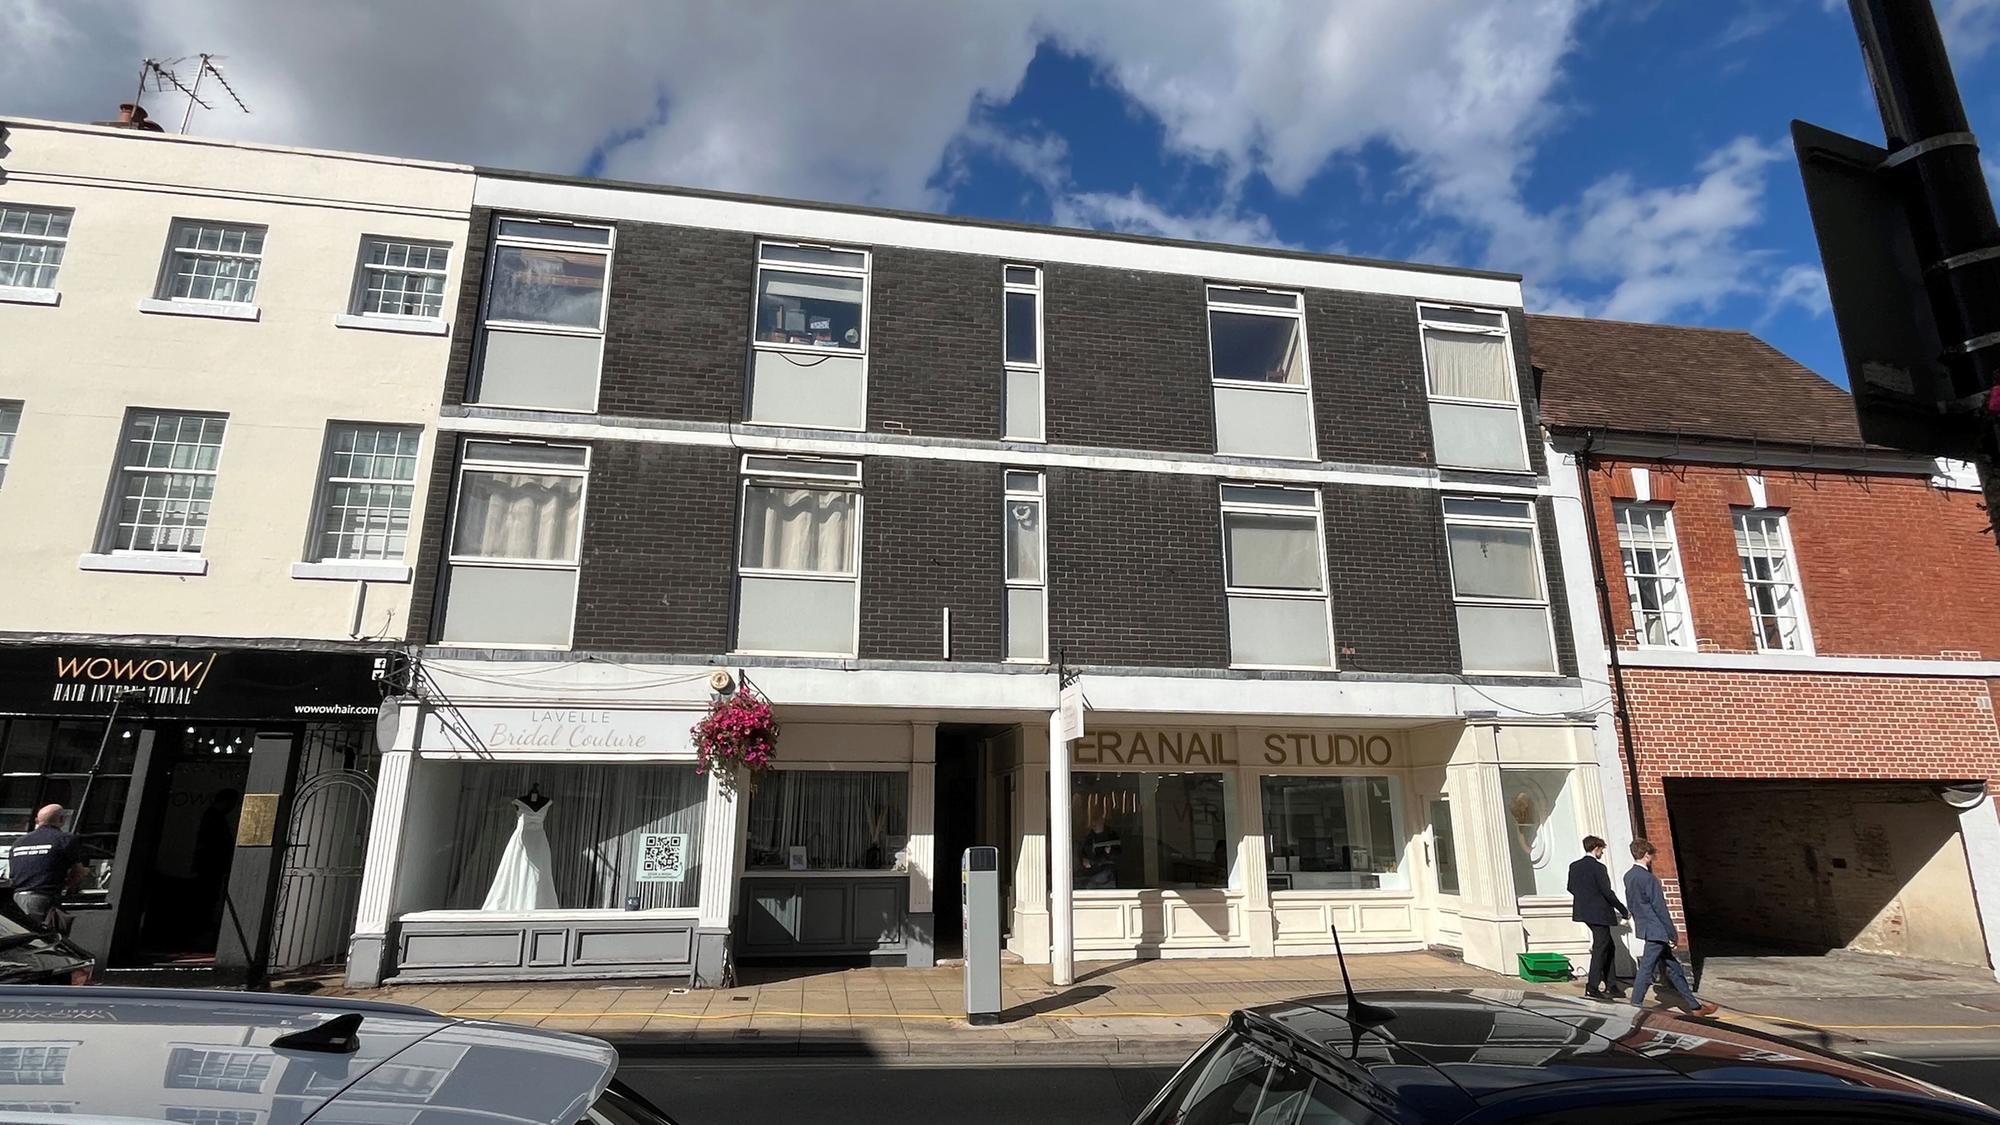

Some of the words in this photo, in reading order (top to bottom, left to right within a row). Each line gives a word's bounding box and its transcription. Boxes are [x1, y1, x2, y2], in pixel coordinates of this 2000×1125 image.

[53, 683, 86, 702] HAIR
[294, 704, 379, 715] wowowhair.com
[531, 711, 610, 724] LAVELLE
[489, 722, 563, 747] Bridal
[568, 724, 647, 748] Couture
[1263, 733, 1392, 766] STUDIO
